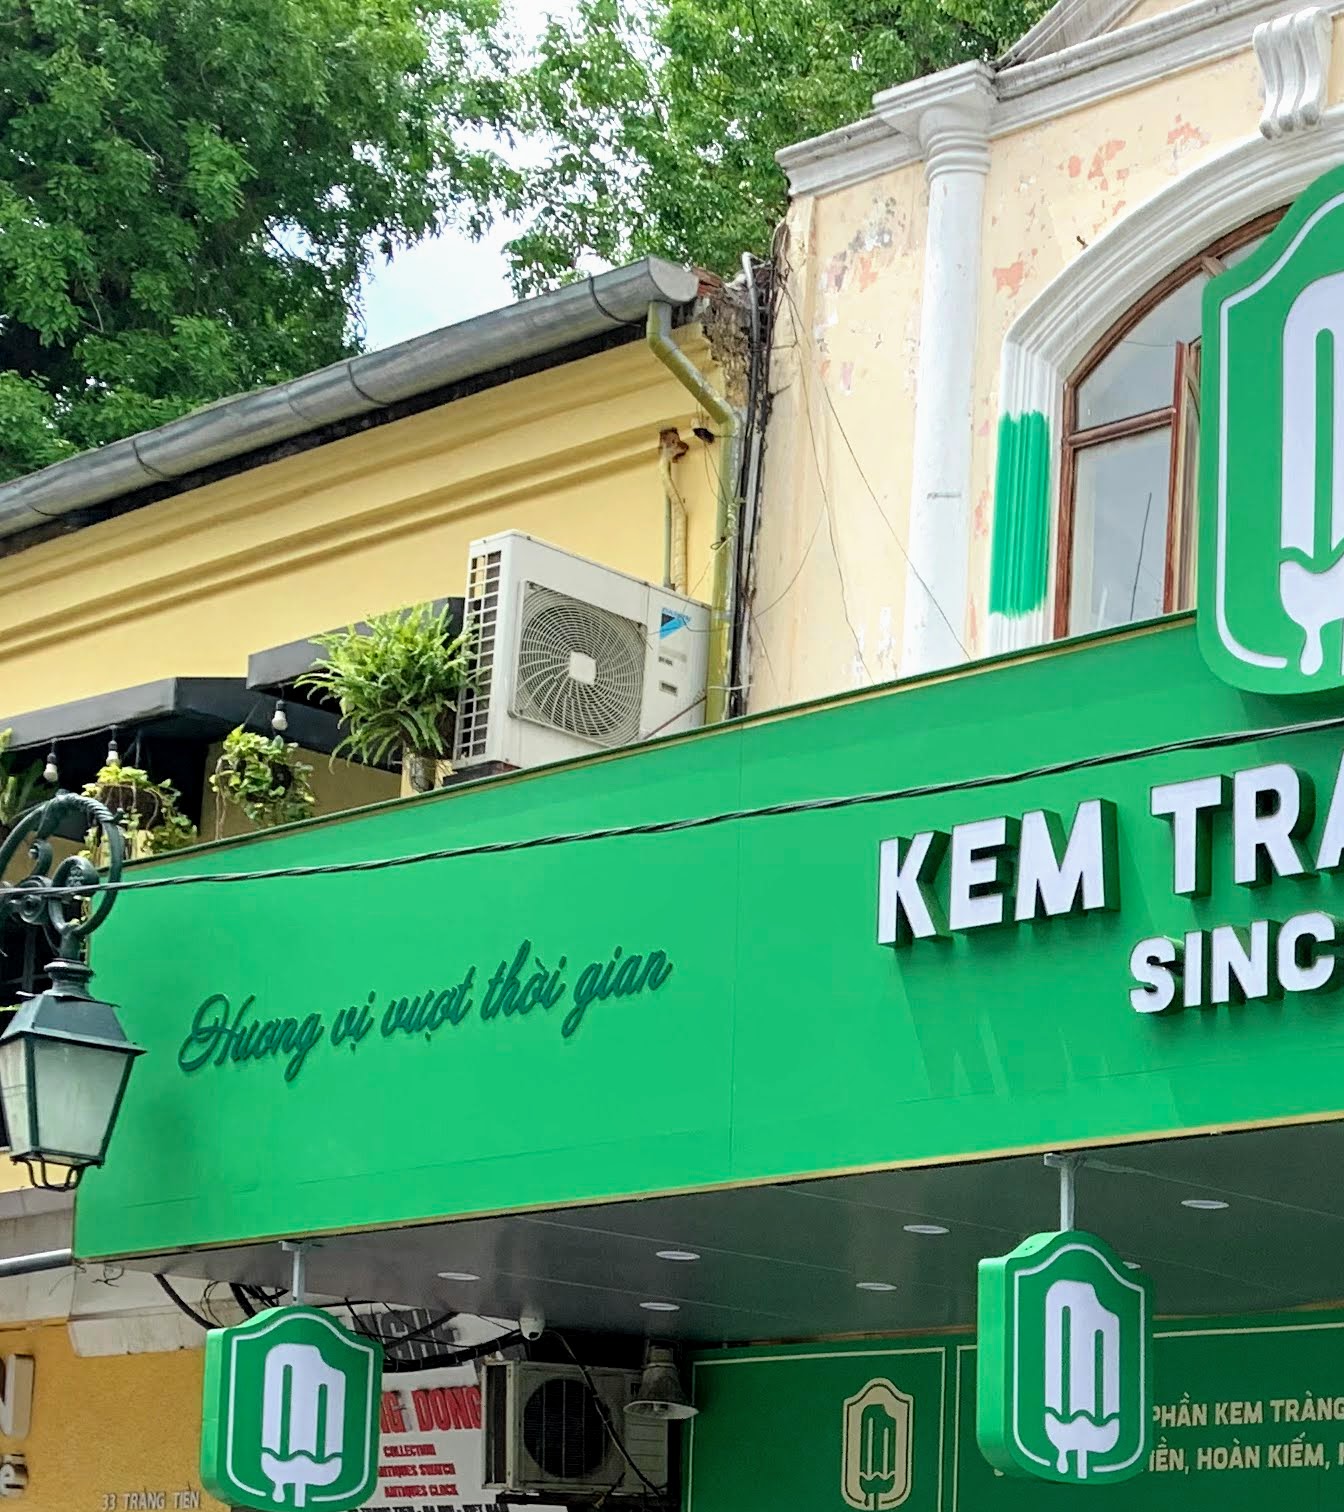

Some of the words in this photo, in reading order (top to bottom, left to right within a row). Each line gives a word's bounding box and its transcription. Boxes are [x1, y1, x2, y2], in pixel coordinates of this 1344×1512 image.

[877, 797, 1119, 947] KEM
[330, 991, 374, 1054] vị
[480, 939, 568, 1021] thời
[561, 946, 673, 1037] gian
[1214, 1401, 1263, 1425] KEM
[1149, 1436, 1189, 1475] IỀN,
[1197, 1438, 1260, 1470] HOÀN
